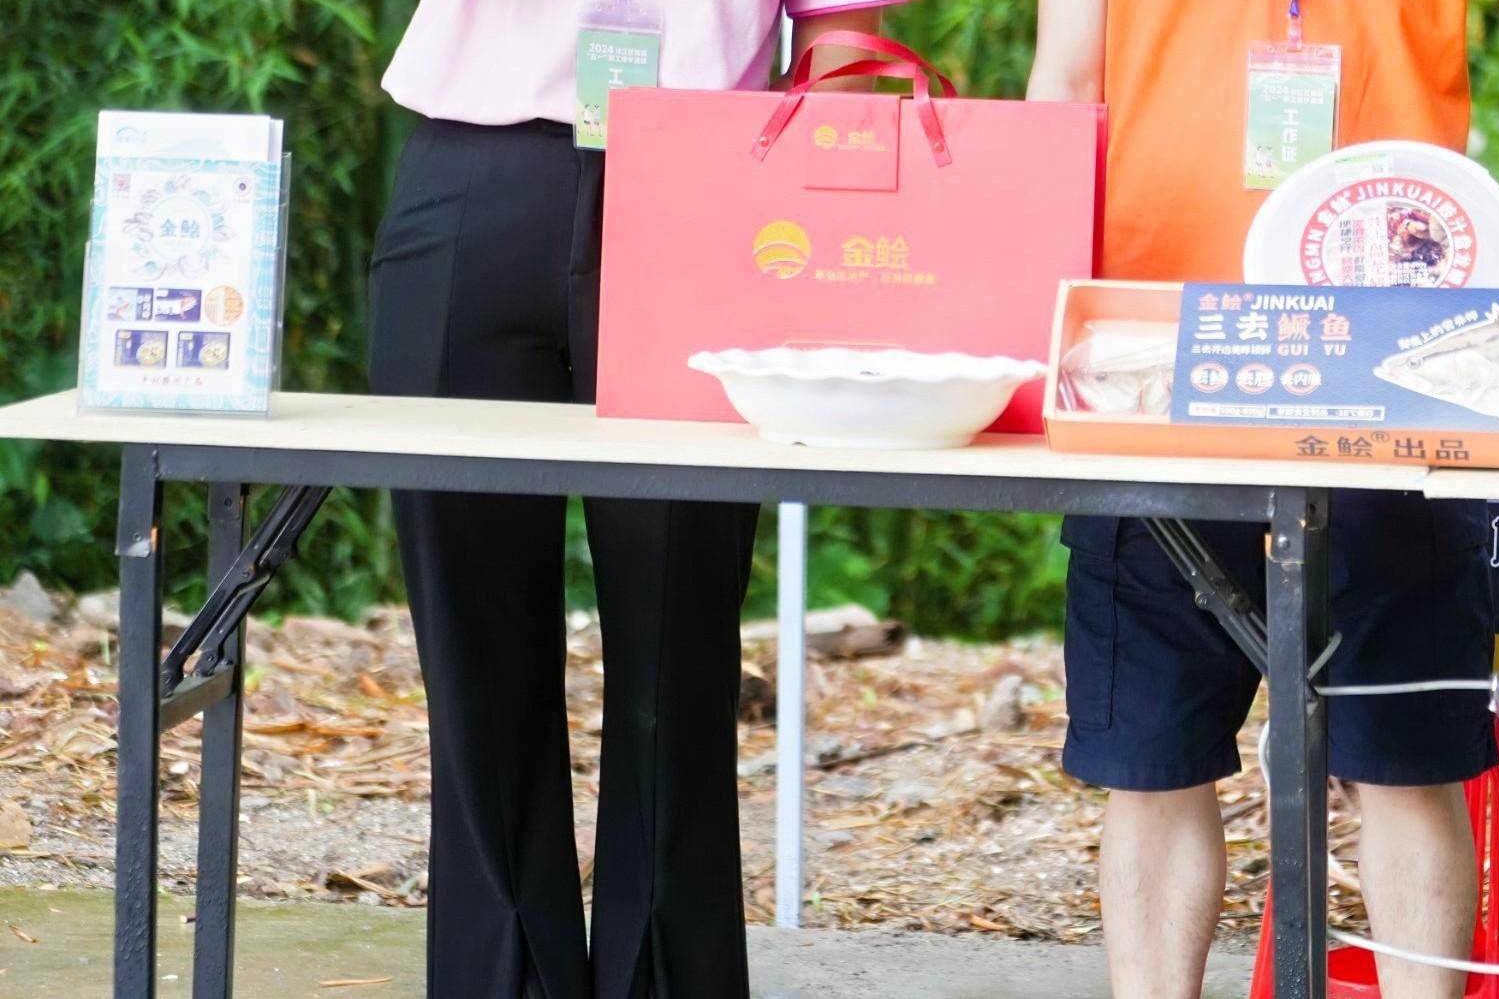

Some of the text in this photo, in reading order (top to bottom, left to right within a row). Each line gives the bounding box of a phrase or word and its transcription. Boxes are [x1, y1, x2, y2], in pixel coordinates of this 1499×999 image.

[1356, 181, 1443, 211] JINKUAI
[1250, 294, 1335, 312] JINKUAI
[1276, 344, 1348, 357] GUI YU
